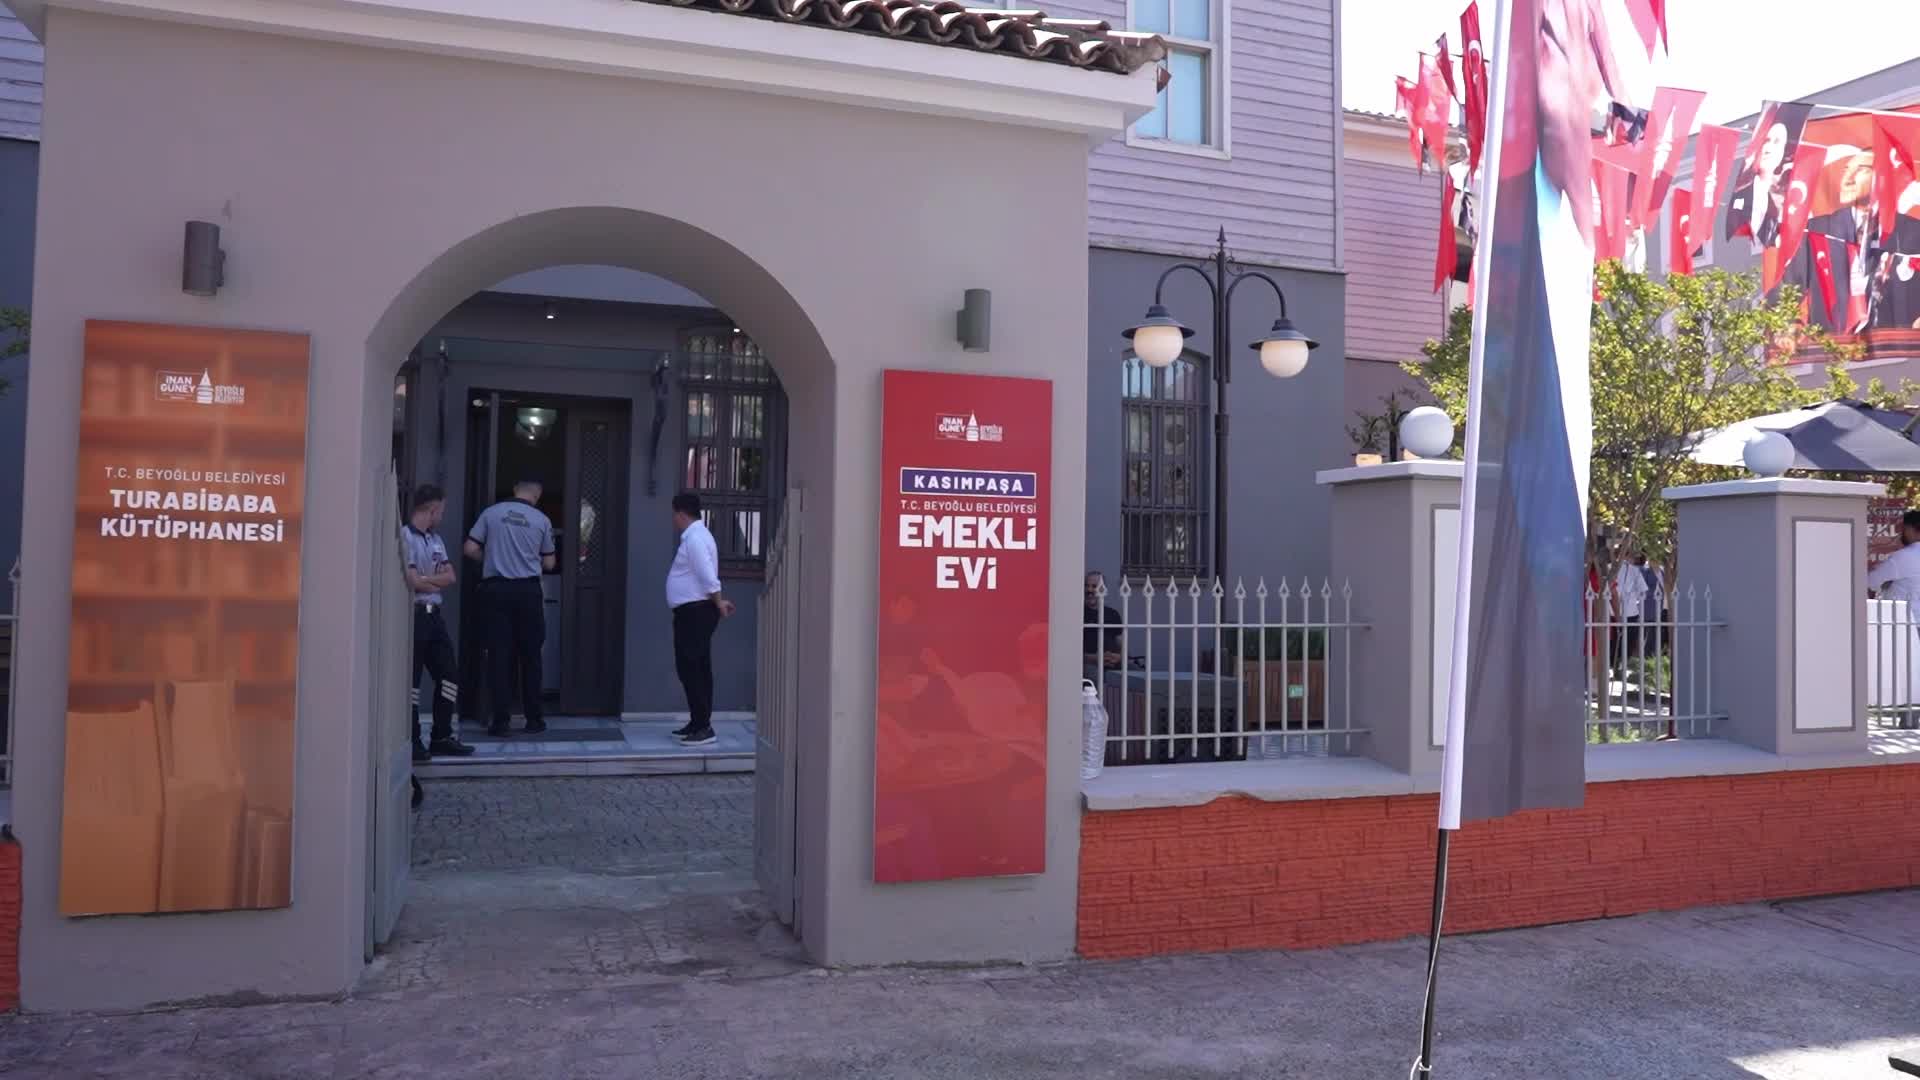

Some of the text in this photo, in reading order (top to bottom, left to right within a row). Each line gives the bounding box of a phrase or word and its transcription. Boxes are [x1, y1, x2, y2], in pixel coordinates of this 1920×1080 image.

[105, 467, 285, 485] T.C. BEYOĞLU BELEDİYESİ
[914, 474, 1023, 493] KASIMPAŞA
[110, 488, 277, 514] TURABİBABA
[901, 500, 1037, 514] T.C. BEYOĞLU BELEDİYESİ
[101, 513, 283, 543] KÜTÜPHANESİ
